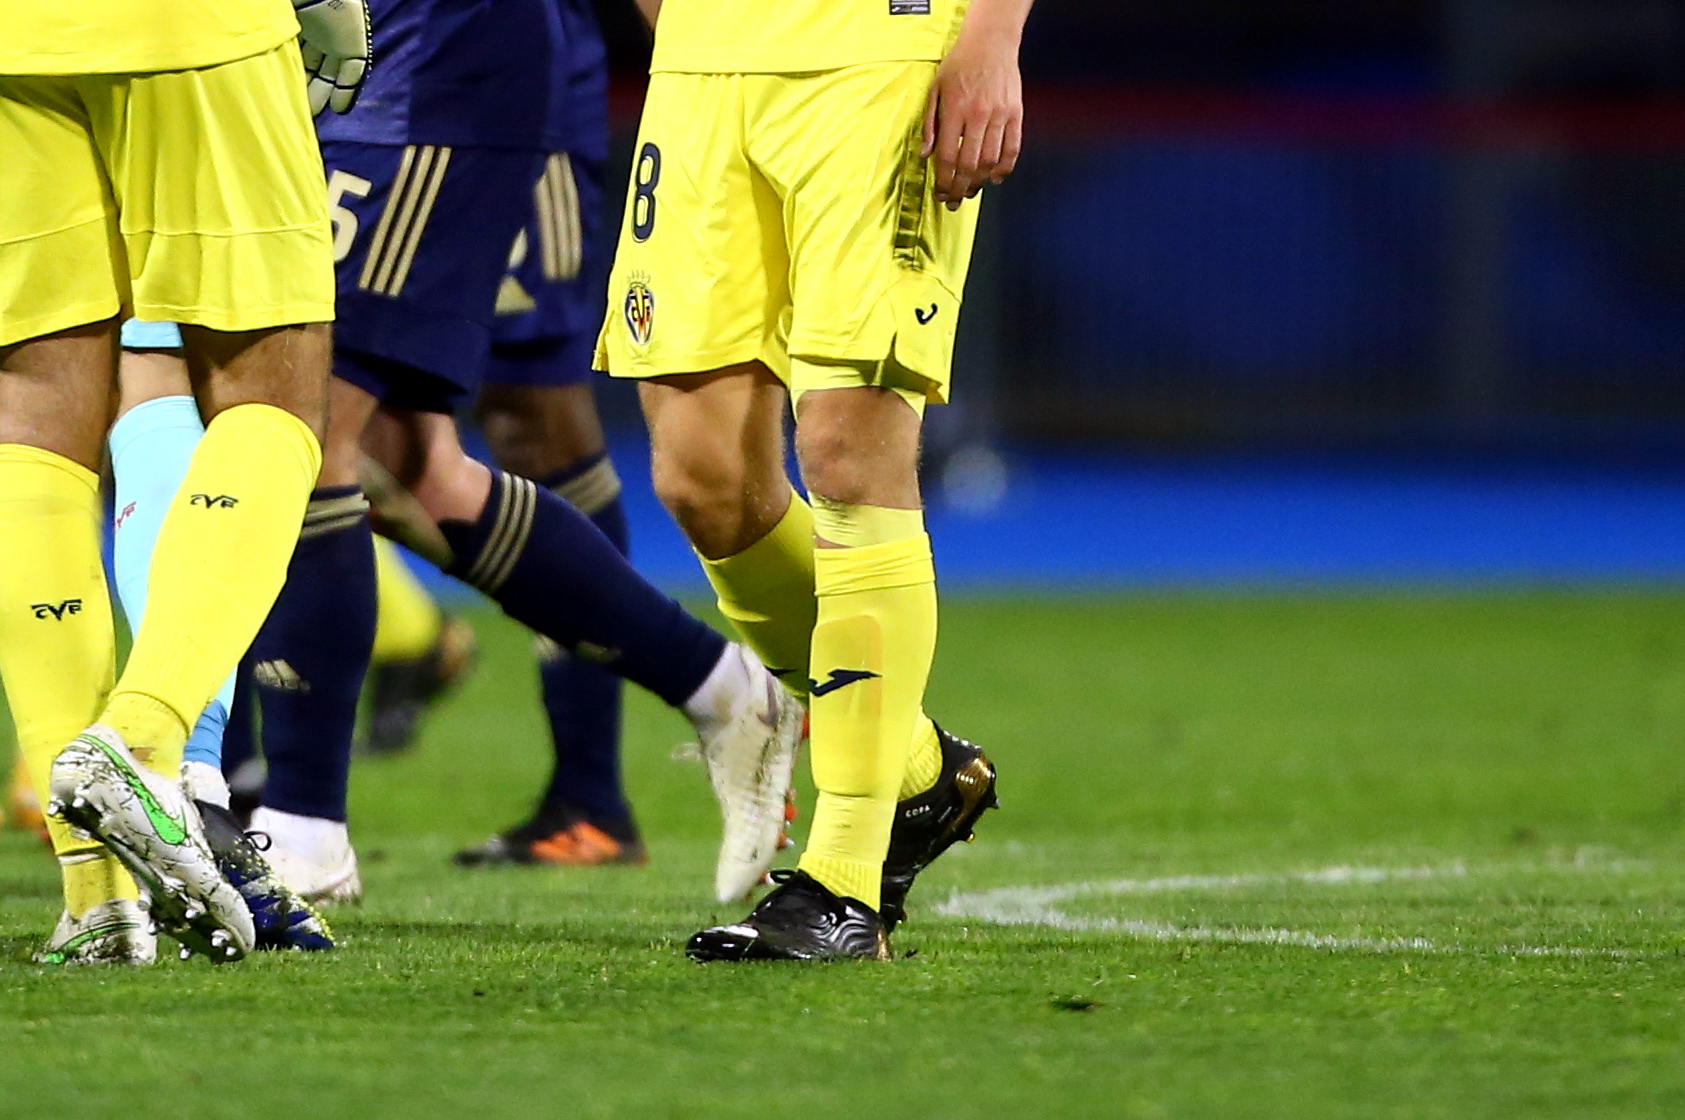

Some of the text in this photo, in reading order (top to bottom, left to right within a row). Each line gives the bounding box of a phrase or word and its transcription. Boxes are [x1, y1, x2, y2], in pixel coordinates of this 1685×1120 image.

[328, 169, 373, 262] 5
[632, 142, 661, 243] 8
[32, 598, 82, 621] CVF
[905, 804, 931, 818] COPA
